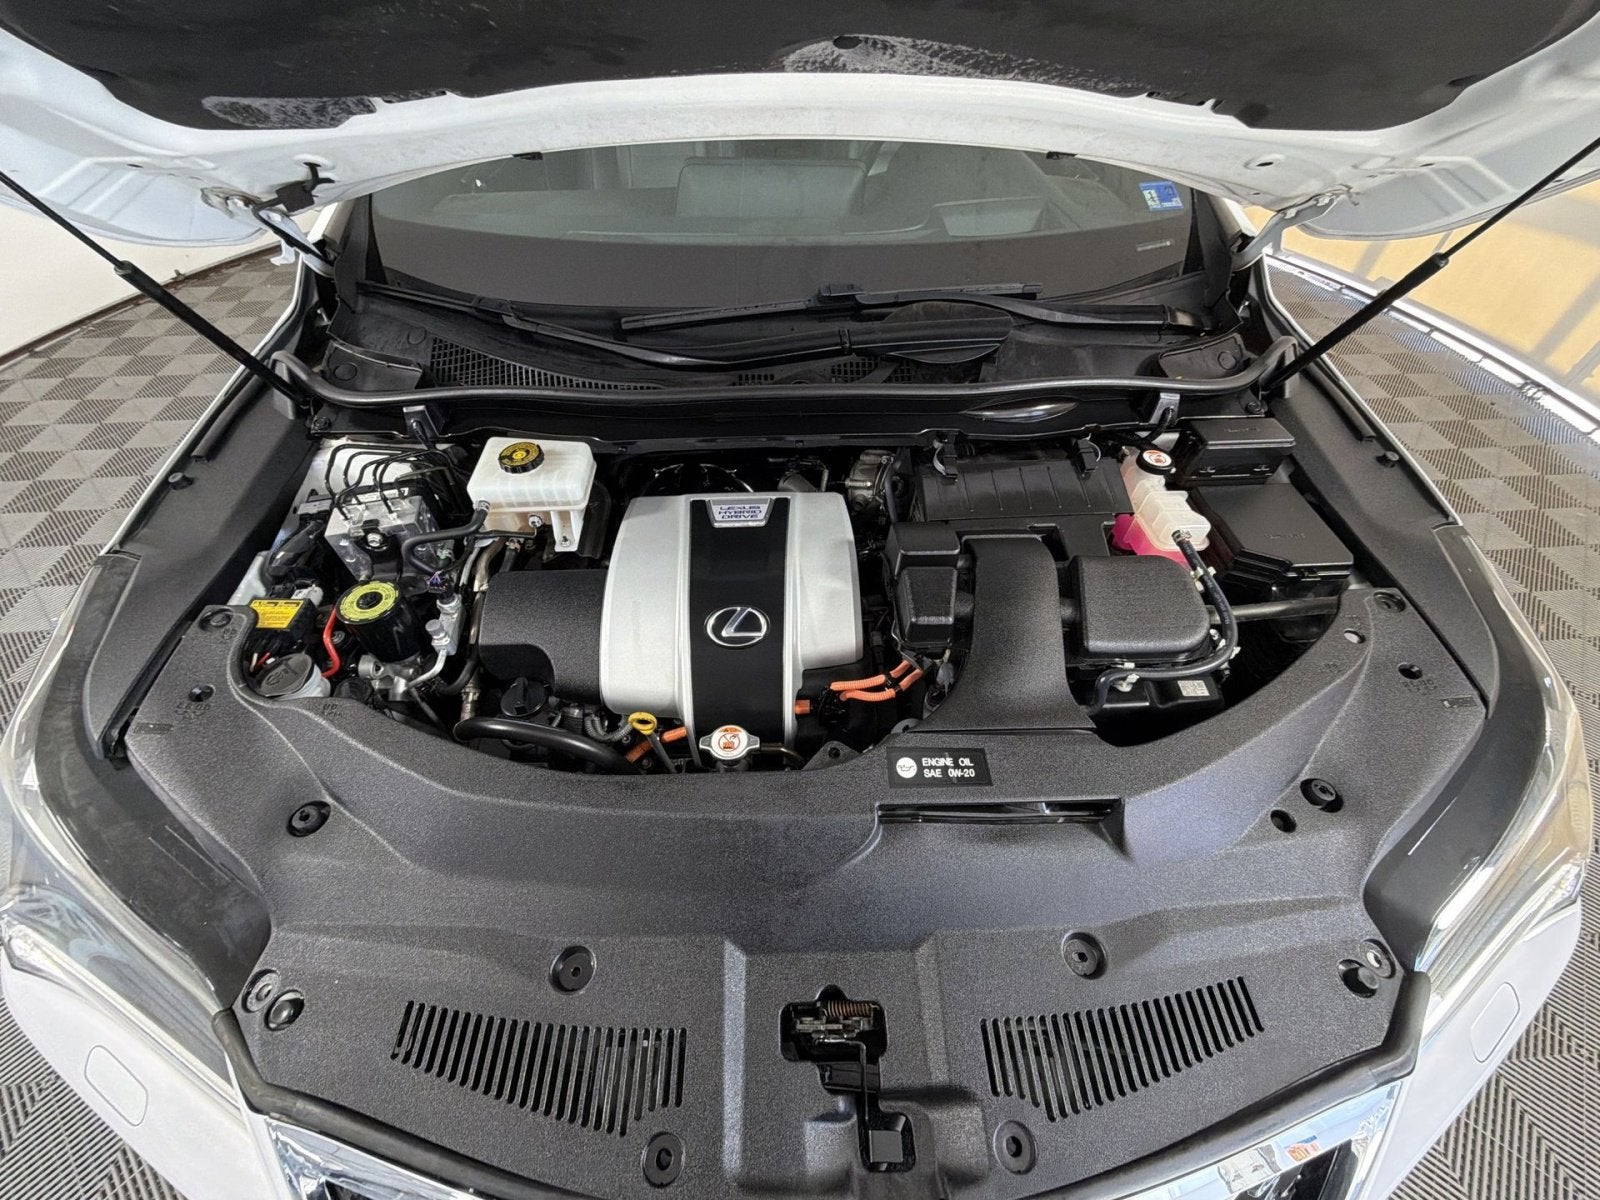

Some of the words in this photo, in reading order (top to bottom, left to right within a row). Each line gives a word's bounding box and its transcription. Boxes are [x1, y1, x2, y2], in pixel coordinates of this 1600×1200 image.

[921, 757, 955, 767] ENGINE
[958, 757, 974, 767] OIL
[923, 768, 943, 778] SAE
[947, 768, 976, 778] 0W-20
